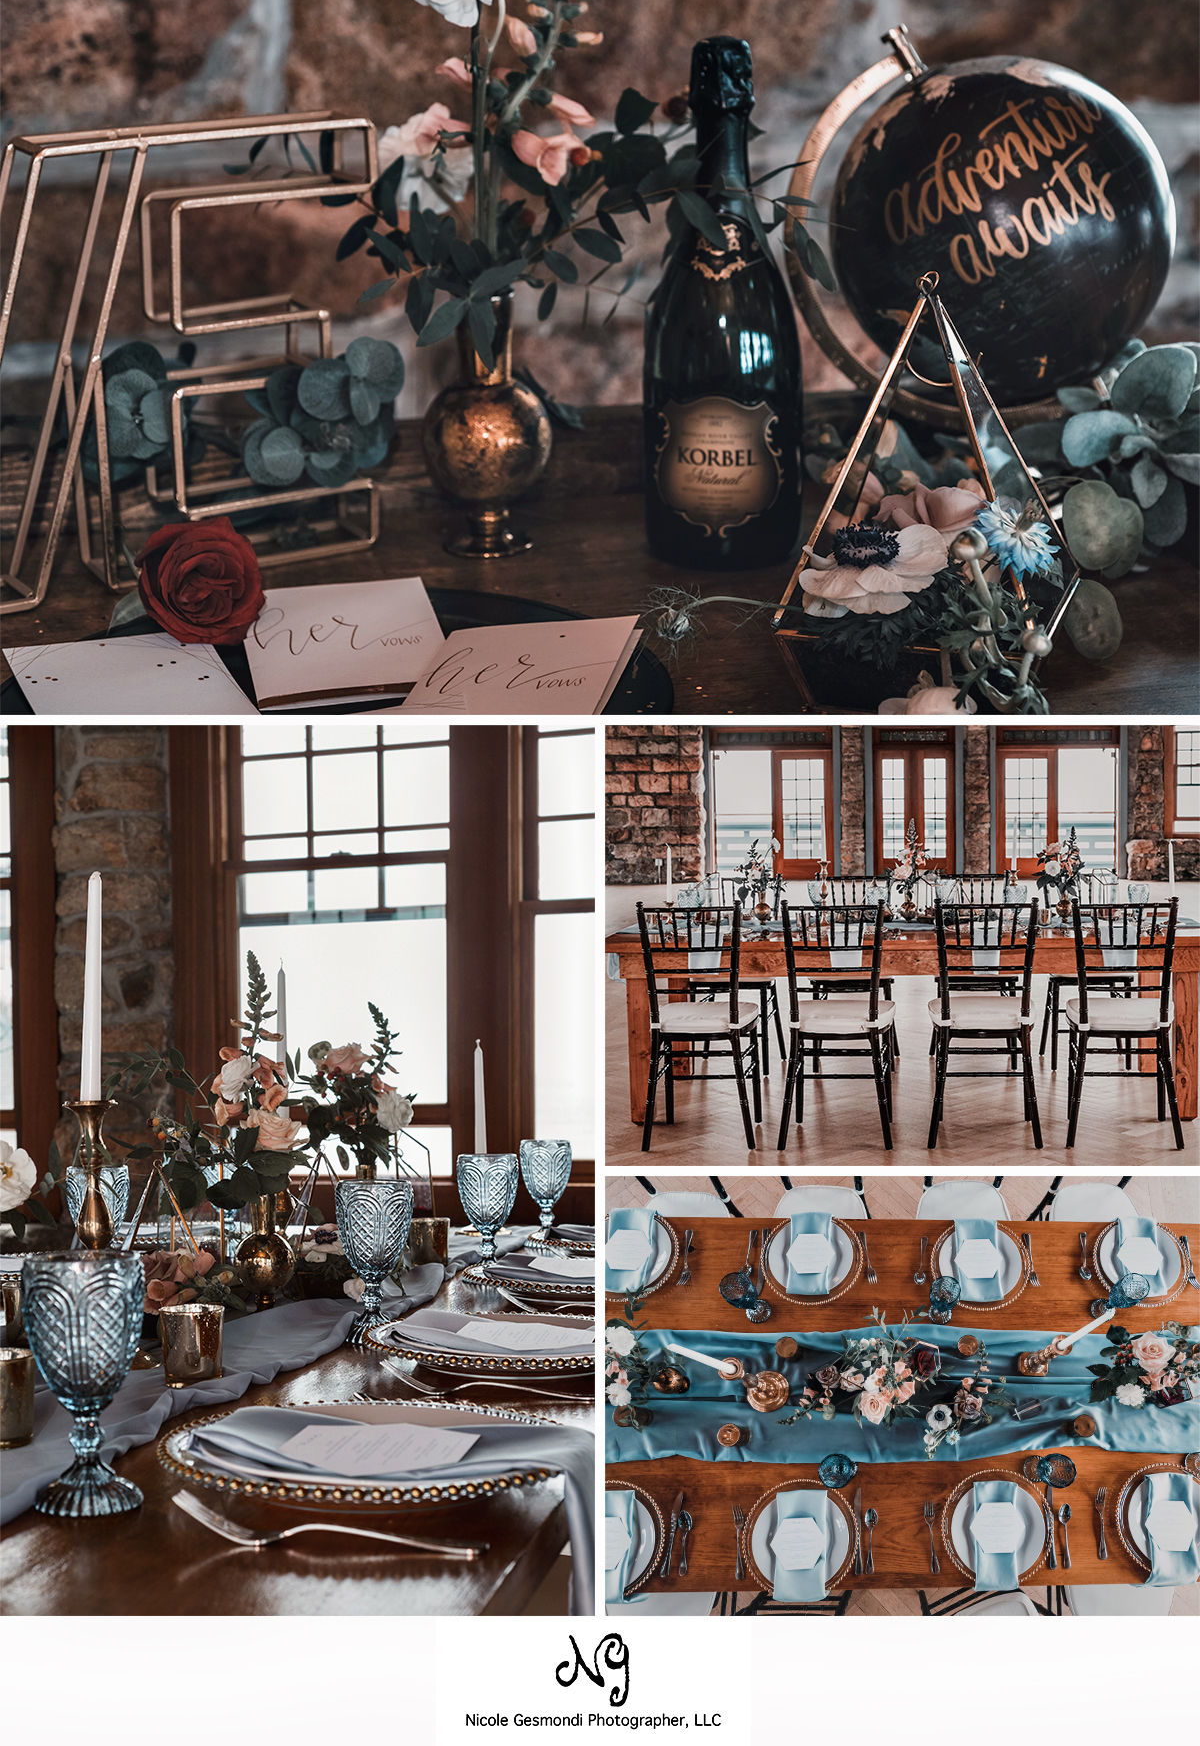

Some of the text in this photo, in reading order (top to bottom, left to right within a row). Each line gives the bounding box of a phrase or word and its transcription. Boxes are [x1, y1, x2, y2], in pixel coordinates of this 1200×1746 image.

[884, 92, 1102, 244] adventure
[950, 143, 1116, 284] awaits
[678, 445, 758, 467] KORBEL
[691, 467, 752, 486] Natural
[246, 607, 433, 656] her
[422, 647, 618, 695] her
